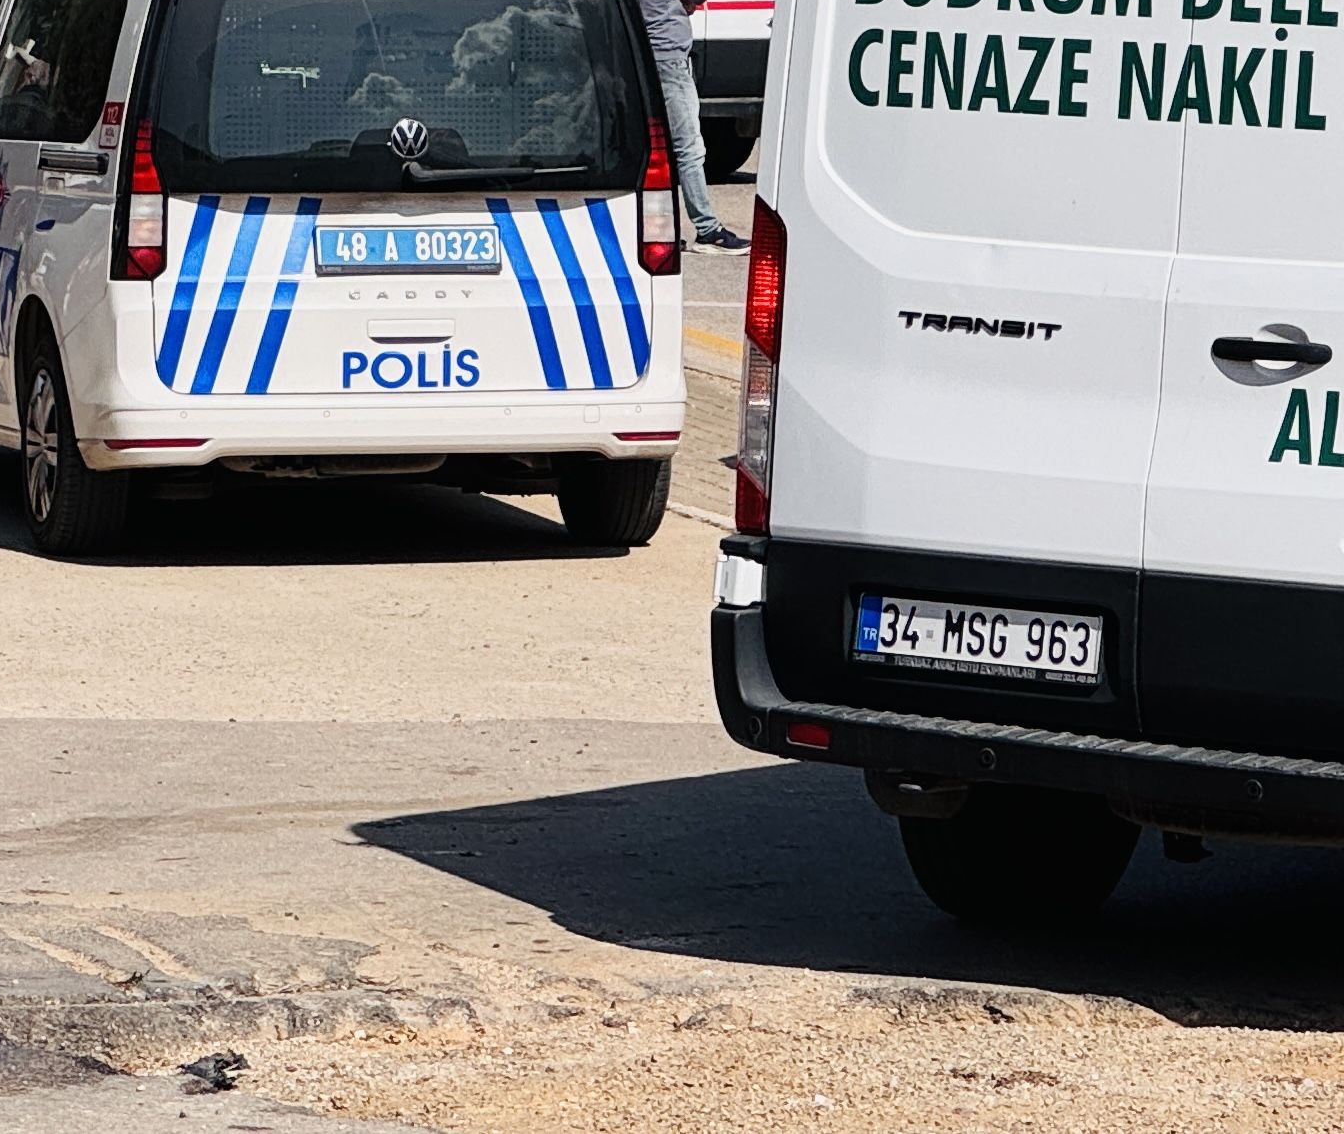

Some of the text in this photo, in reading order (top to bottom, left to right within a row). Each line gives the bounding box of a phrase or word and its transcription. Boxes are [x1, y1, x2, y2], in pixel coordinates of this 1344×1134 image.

[848, 28, 1092, 118] CENAZE
[1117, 27, 1327, 133] NAKİL
[335, 230, 495, 262] 48 A 80323
[348, 288, 473, 301] CADDY
[897, 309, 1063, 341] TRANSIT
[341, 341, 481, 389] POLİS
[863, 603, 1091, 667] TR 34 MSG 963
